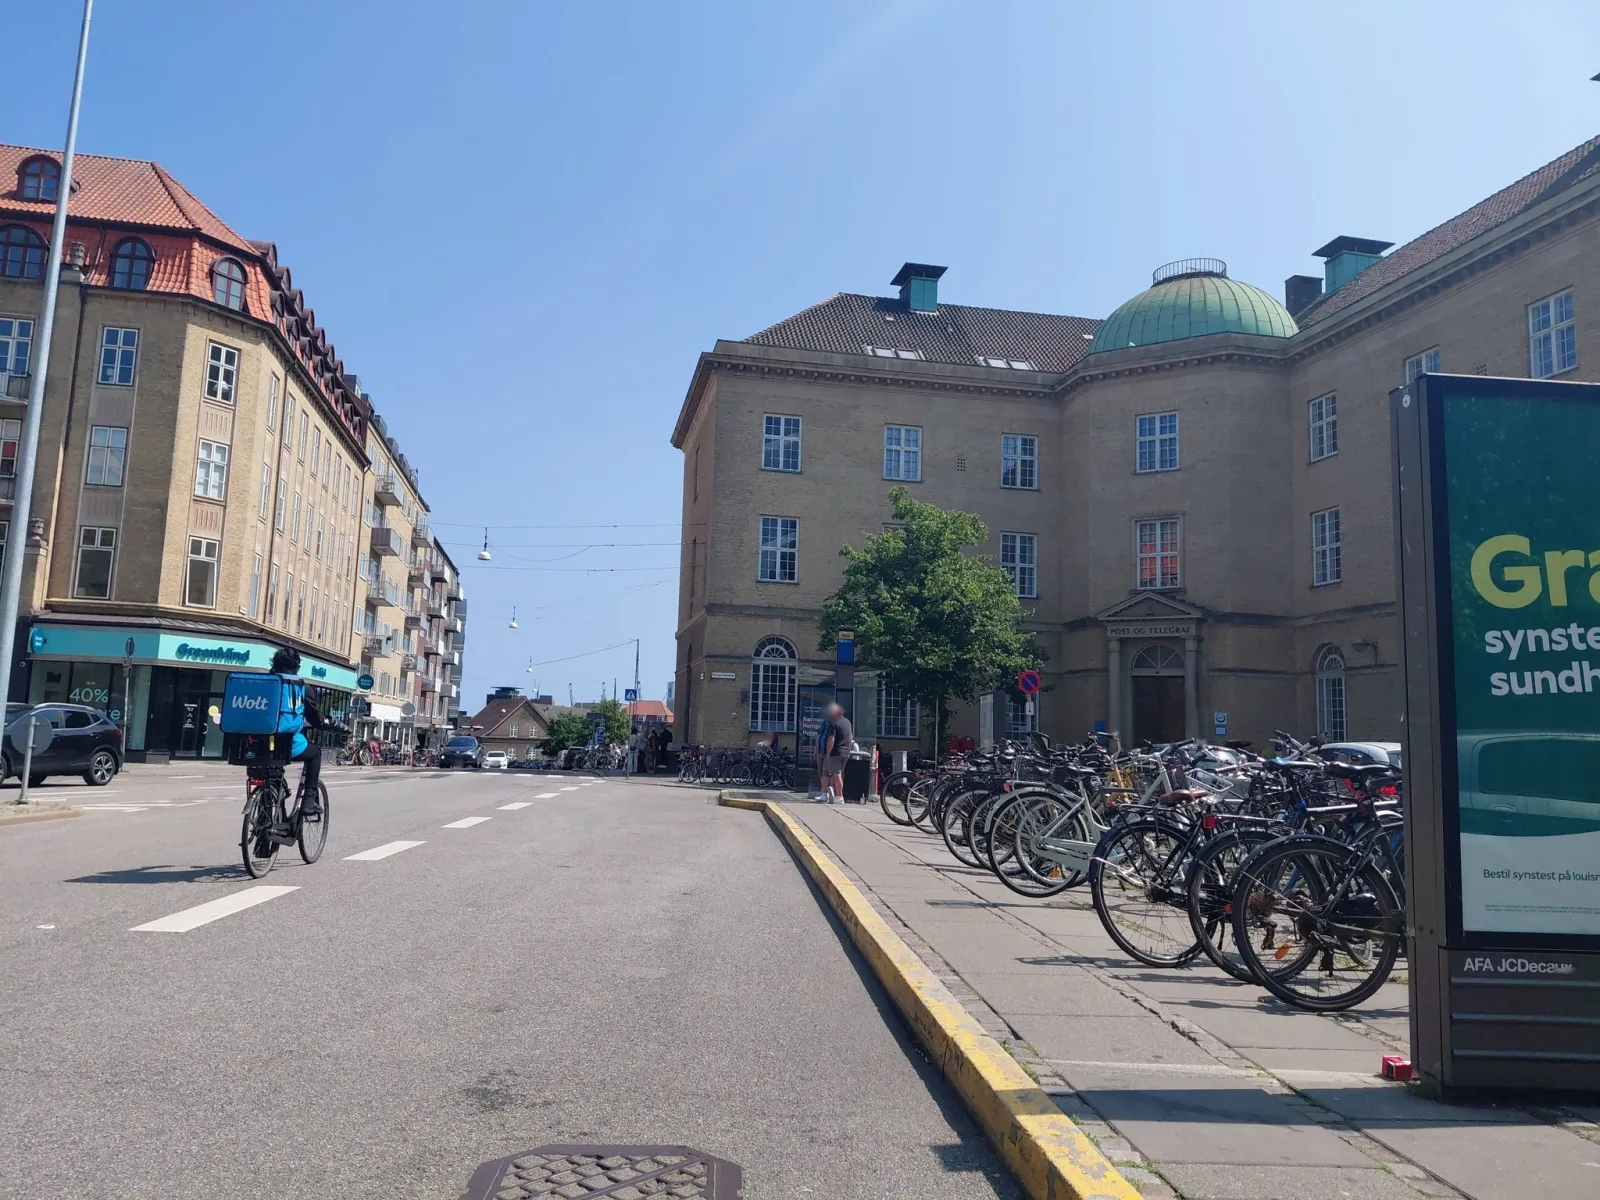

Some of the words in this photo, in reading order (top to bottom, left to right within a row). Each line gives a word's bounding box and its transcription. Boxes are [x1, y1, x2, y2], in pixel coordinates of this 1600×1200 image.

[1471, 534, 1600, 609] Gr
[1110, 627, 1130, 635] POST
[1133, 627, 1146, 635] OG
[1148, 626, 1192, 634] TELEGRAF
[1485, 622, 1600, 660] synste
[1490, 661, 1600, 696] sundh
[69, 688, 109, 703] 40%
[232, 695, 269, 710] Wolt
[1483, 869, 1510, 879] Bestil
[1512, 871, 1556, 881] synstest
[1558, 870, 1571, 882] på
[1463, 958, 1494, 972] AFA
